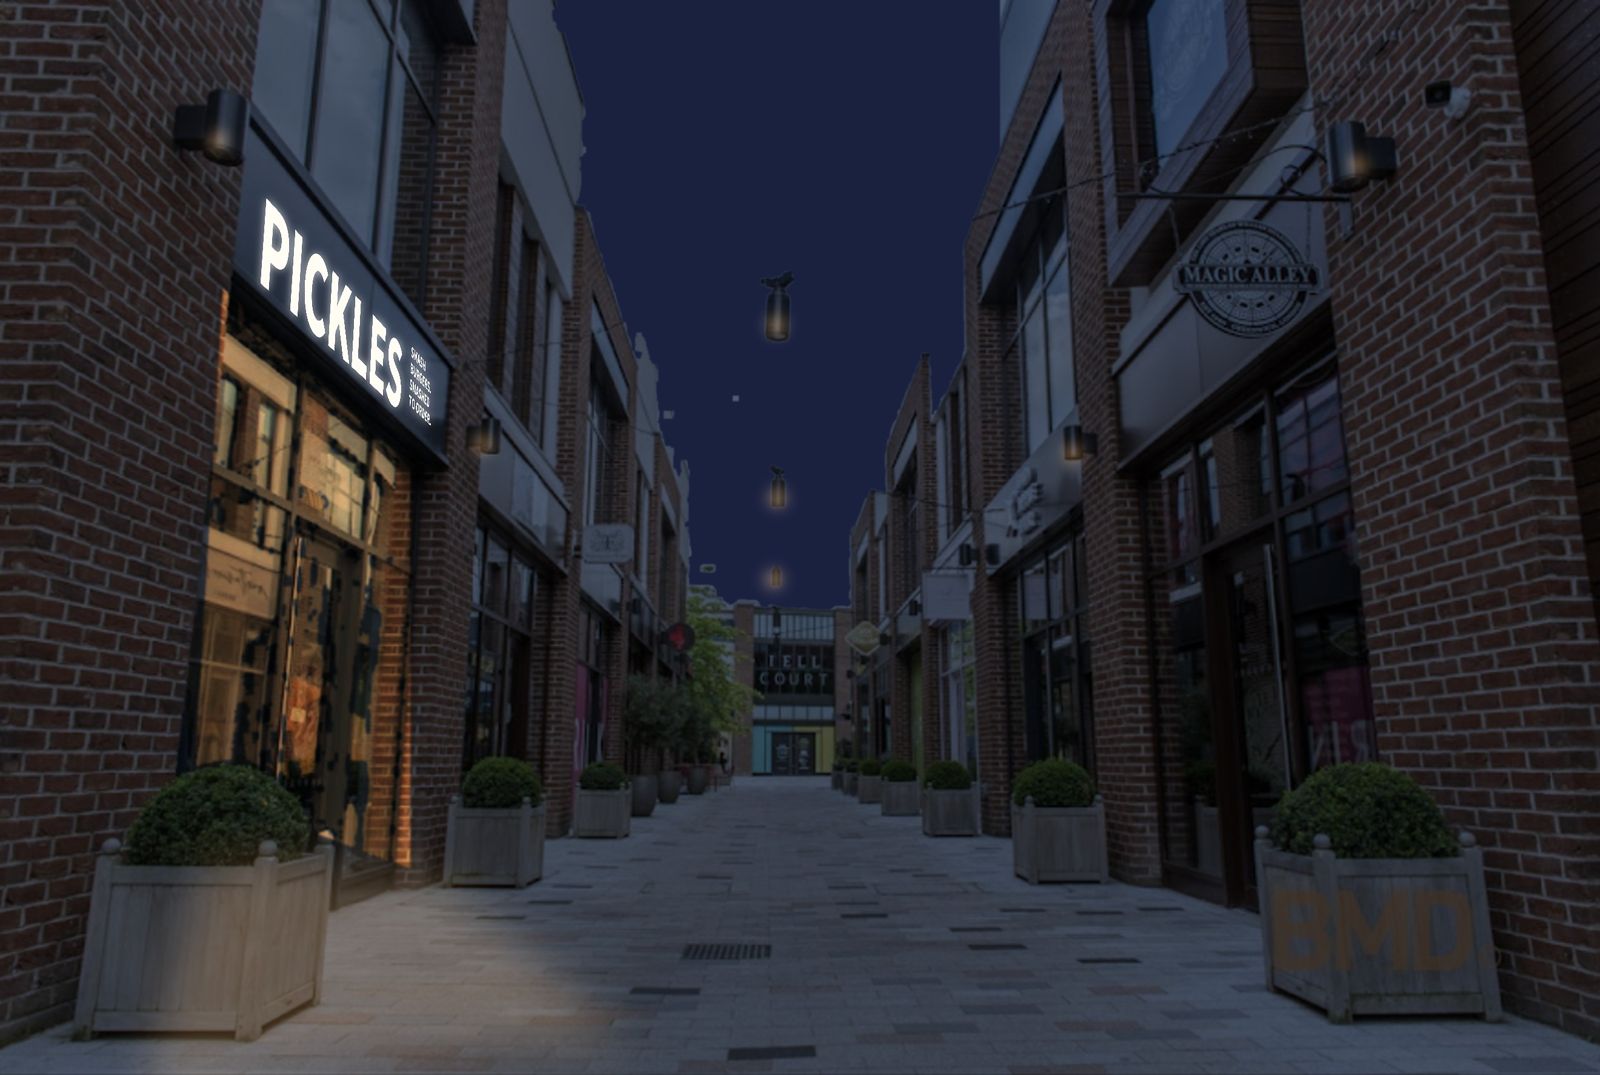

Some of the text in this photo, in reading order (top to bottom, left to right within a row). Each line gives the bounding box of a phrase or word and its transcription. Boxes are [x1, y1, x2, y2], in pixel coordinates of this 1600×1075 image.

[1184, 266, 1311, 283] MAGIC ALLEY
[260, 198, 402, 408] PICKLES
[409, 395, 415, 410] TO
[759, 672, 827, 686] COURT
